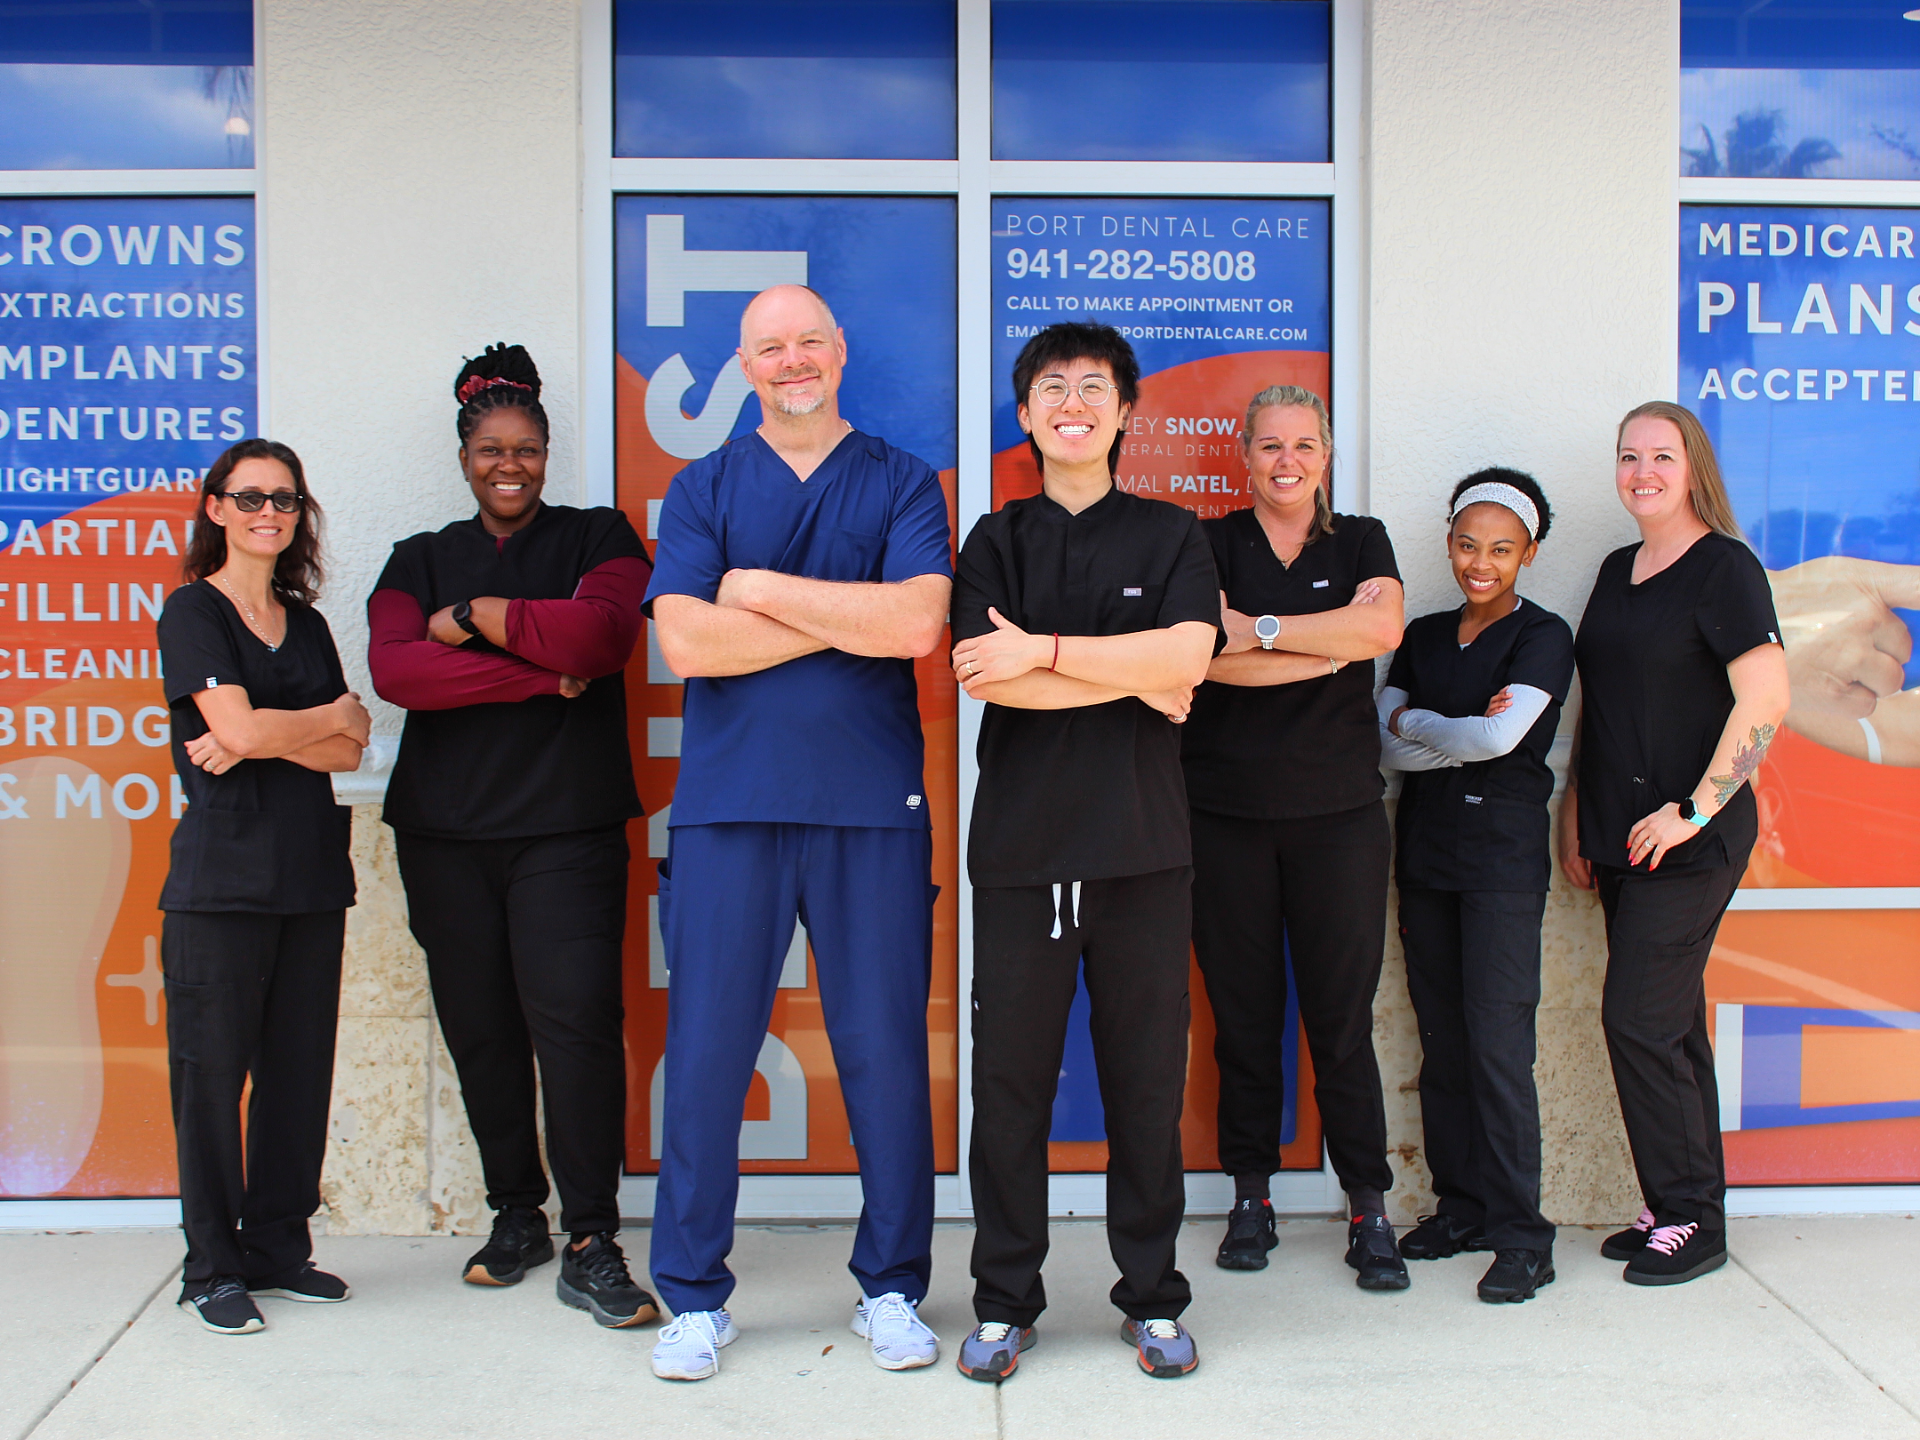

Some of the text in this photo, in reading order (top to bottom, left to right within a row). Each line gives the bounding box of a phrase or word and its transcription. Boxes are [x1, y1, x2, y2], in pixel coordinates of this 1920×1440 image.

[1006, 214, 1310, 239] PORT DENTAL CARE
[1698, 222, 1915, 258] MEDICAR
[1006, 247, 1257, 282] 941-282-5808
[0, 292, 246, 319] XTRACTIONS
[1006, 295, 1294, 313] CALL TO MAKE APPOINTMENT OR
[1006, 325, 1050, 338] EMA
[0, 345, 246, 381] MPLANTS
[1697, 367, 1920, 402] ACCEPTE
[1165, 416, 1242, 439] SNOW,
[0, 467, 212, 492] IGHTGUAR
[1169, 474, 1240, 497] PATEL,
[0, 648, 164, 680] LEANI
